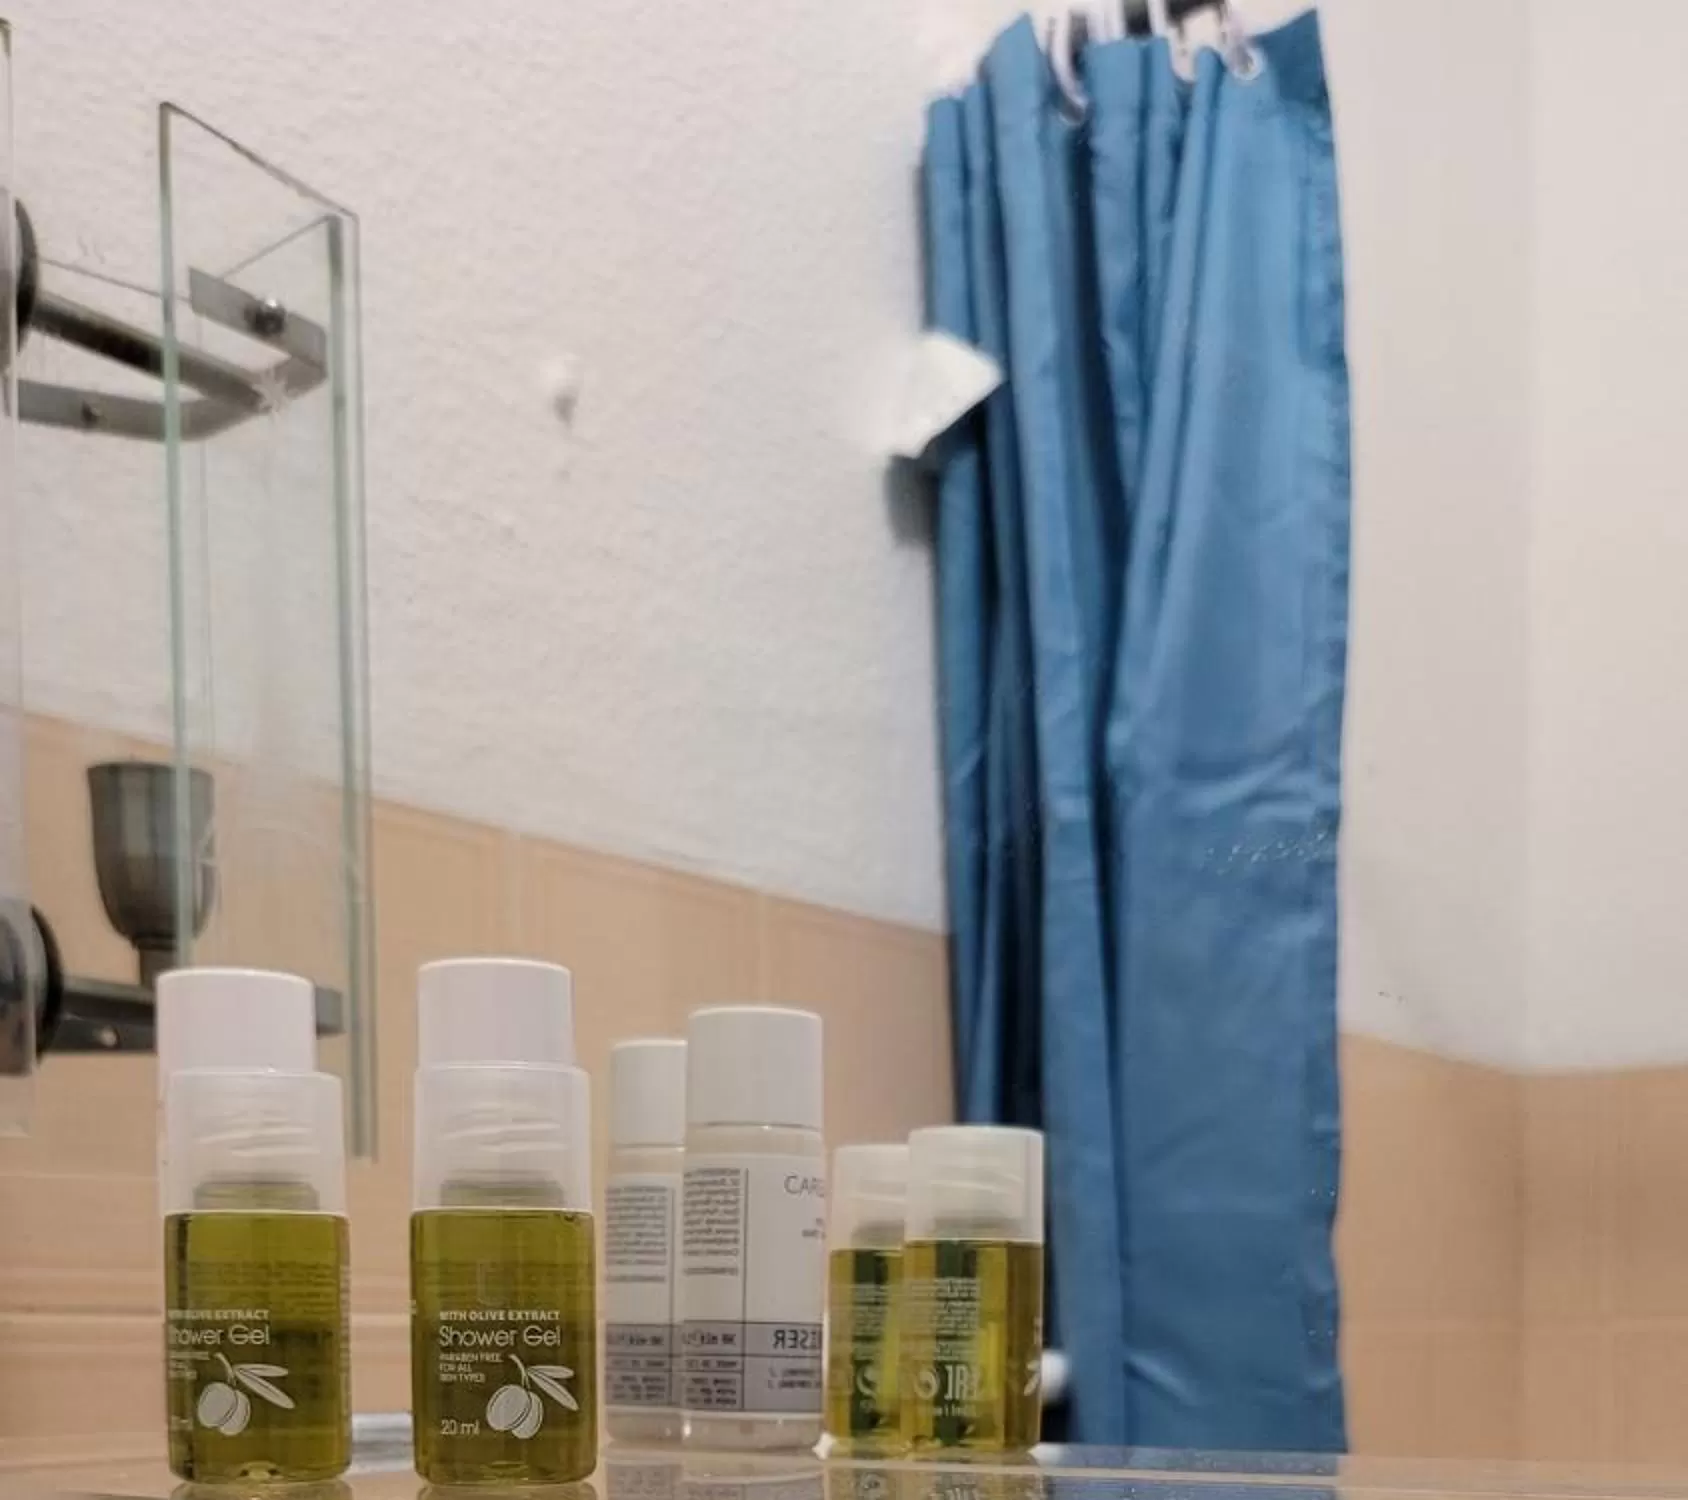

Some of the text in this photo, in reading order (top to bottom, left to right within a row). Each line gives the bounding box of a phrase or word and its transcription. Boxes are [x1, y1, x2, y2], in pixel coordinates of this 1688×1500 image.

[439, 1310, 561, 1321] WITH OLIVE EXTRACT
[228, 1324, 271, 1345] Gel
[439, 1325, 561, 1347] Shower Gel
[440, 1420, 481, 1436] 20 ml
